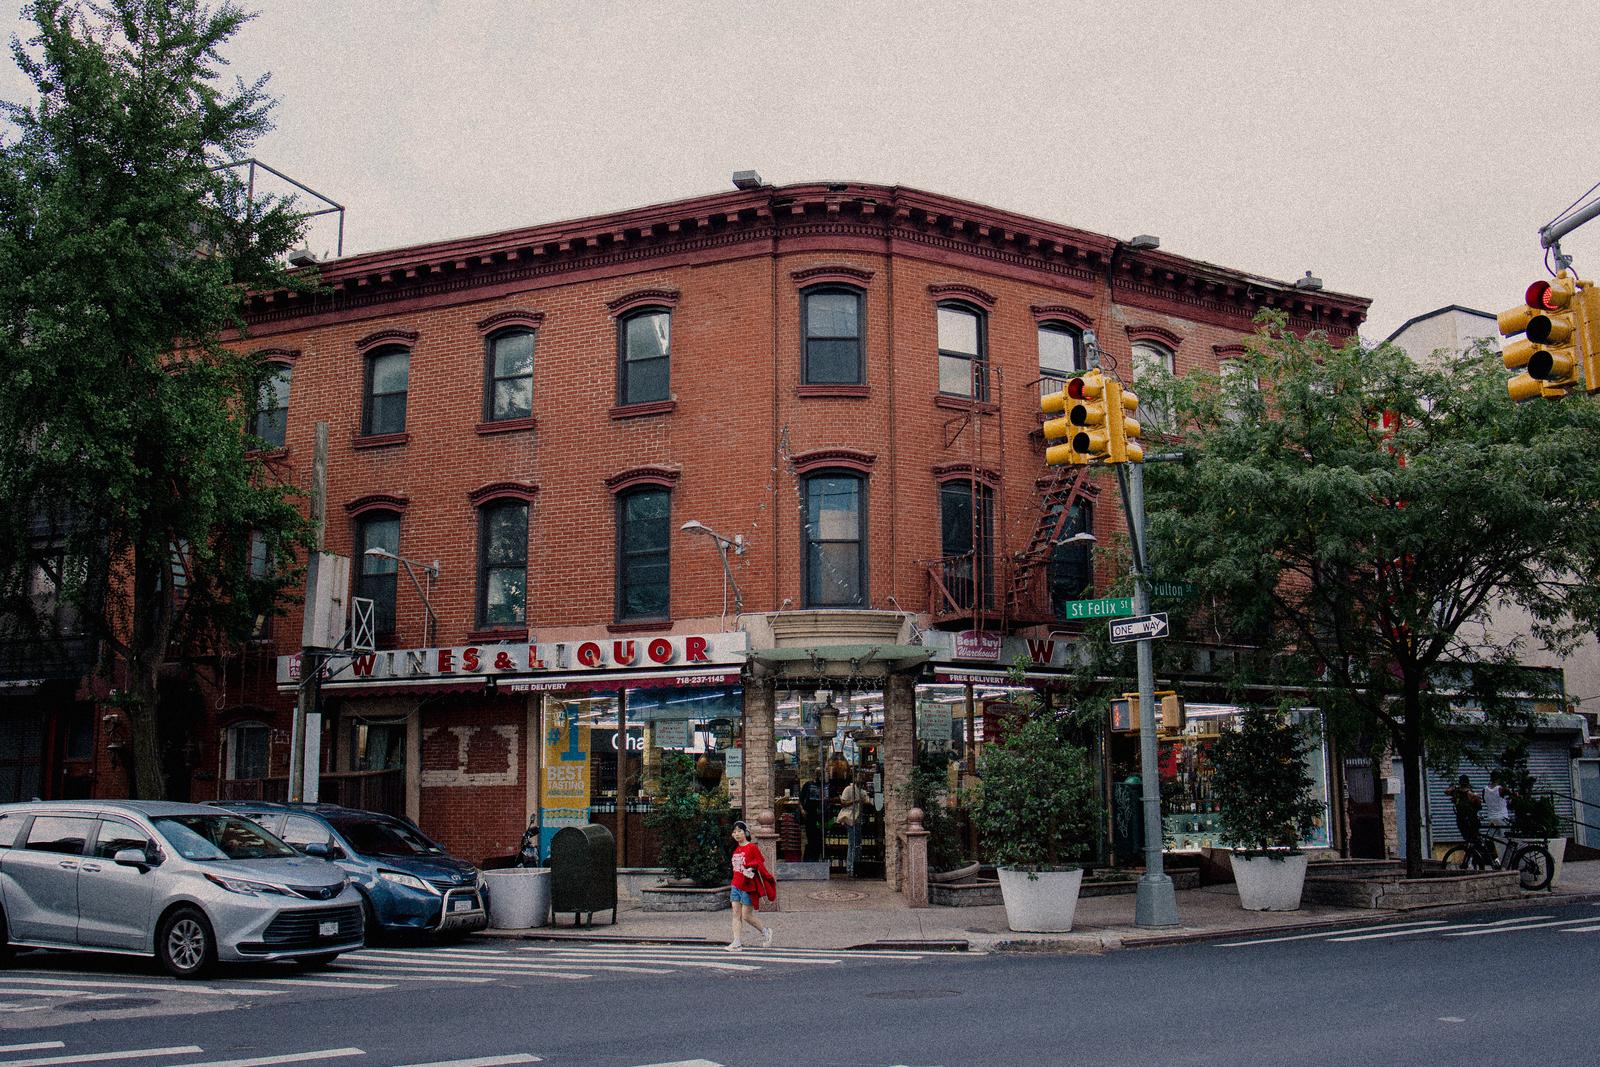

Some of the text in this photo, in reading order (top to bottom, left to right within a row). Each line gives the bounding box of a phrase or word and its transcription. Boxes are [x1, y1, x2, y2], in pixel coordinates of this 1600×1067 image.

[1072, 600, 1128, 616] St Felix St
[1115, 621, 1160, 636] ONE WAY
[957, 636, 978, 647] Best
[351, 647, 479, 677] WINES
[494, 651, 514, 670] &
[528, 636, 710, 668] LIQUOR
[957, 646, 998, 658] Warehouse
[531, 682, 567, 691] DELIVERY
[676, 675, 725, 684] 718-237-1145
[949, 674, 1005, 684] FREE DELIVERY
[547, 766, 584, 781] BEST
